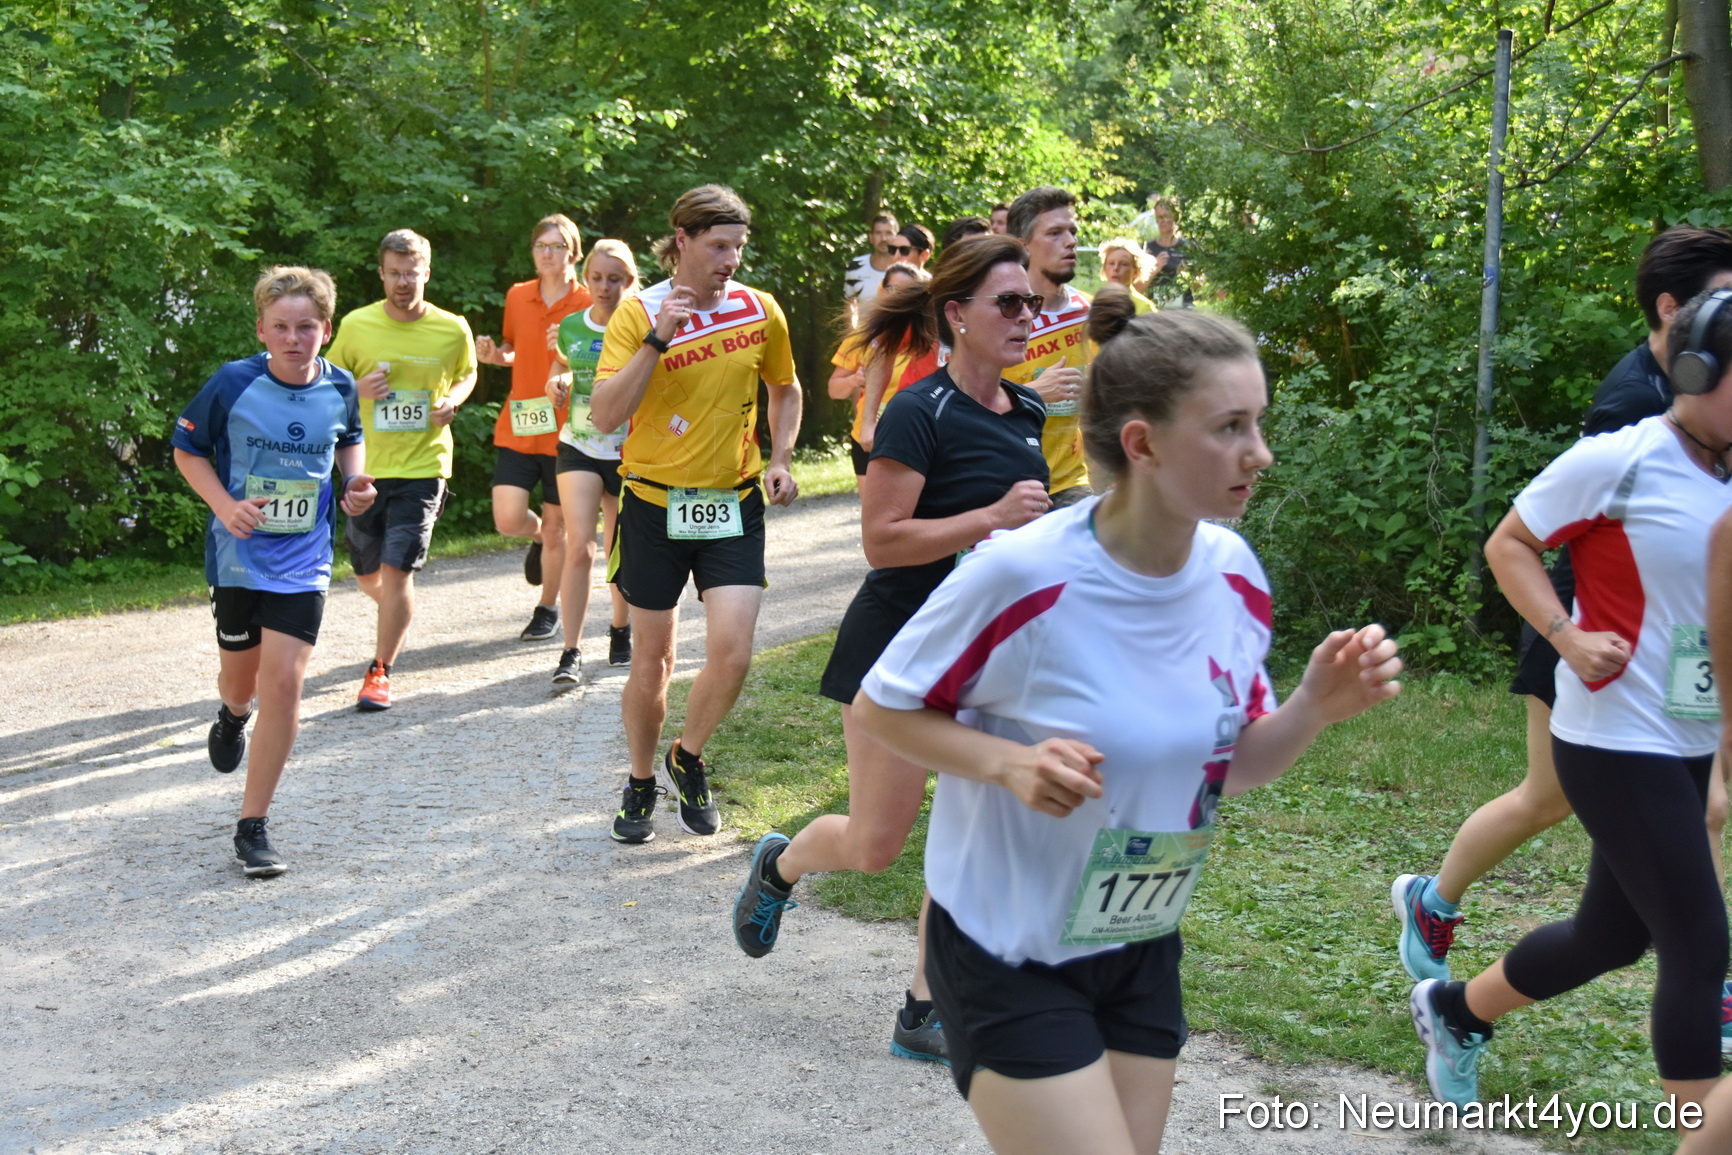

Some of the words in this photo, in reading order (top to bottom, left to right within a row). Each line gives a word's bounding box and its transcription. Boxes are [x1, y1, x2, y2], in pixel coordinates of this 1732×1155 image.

[663, 343, 718, 372] MAX
[721, 328, 768, 354] BÖGL
[1025, 338, 1061, 362] MAX
[381, 405, 423, 420] 1195
[515, 410, 549, 426] 1798
[279, 457, 303, 468] TEAM
[258, 499, 309, 518] 110
[677, 503, 731, 524] 1693
[219, 629, 250, 642] hummel
[1098, 867, 1192, 913] 1777
[1109, 914, 1132, 925] Beer
[1133, 913, 1157, 923] Anna
